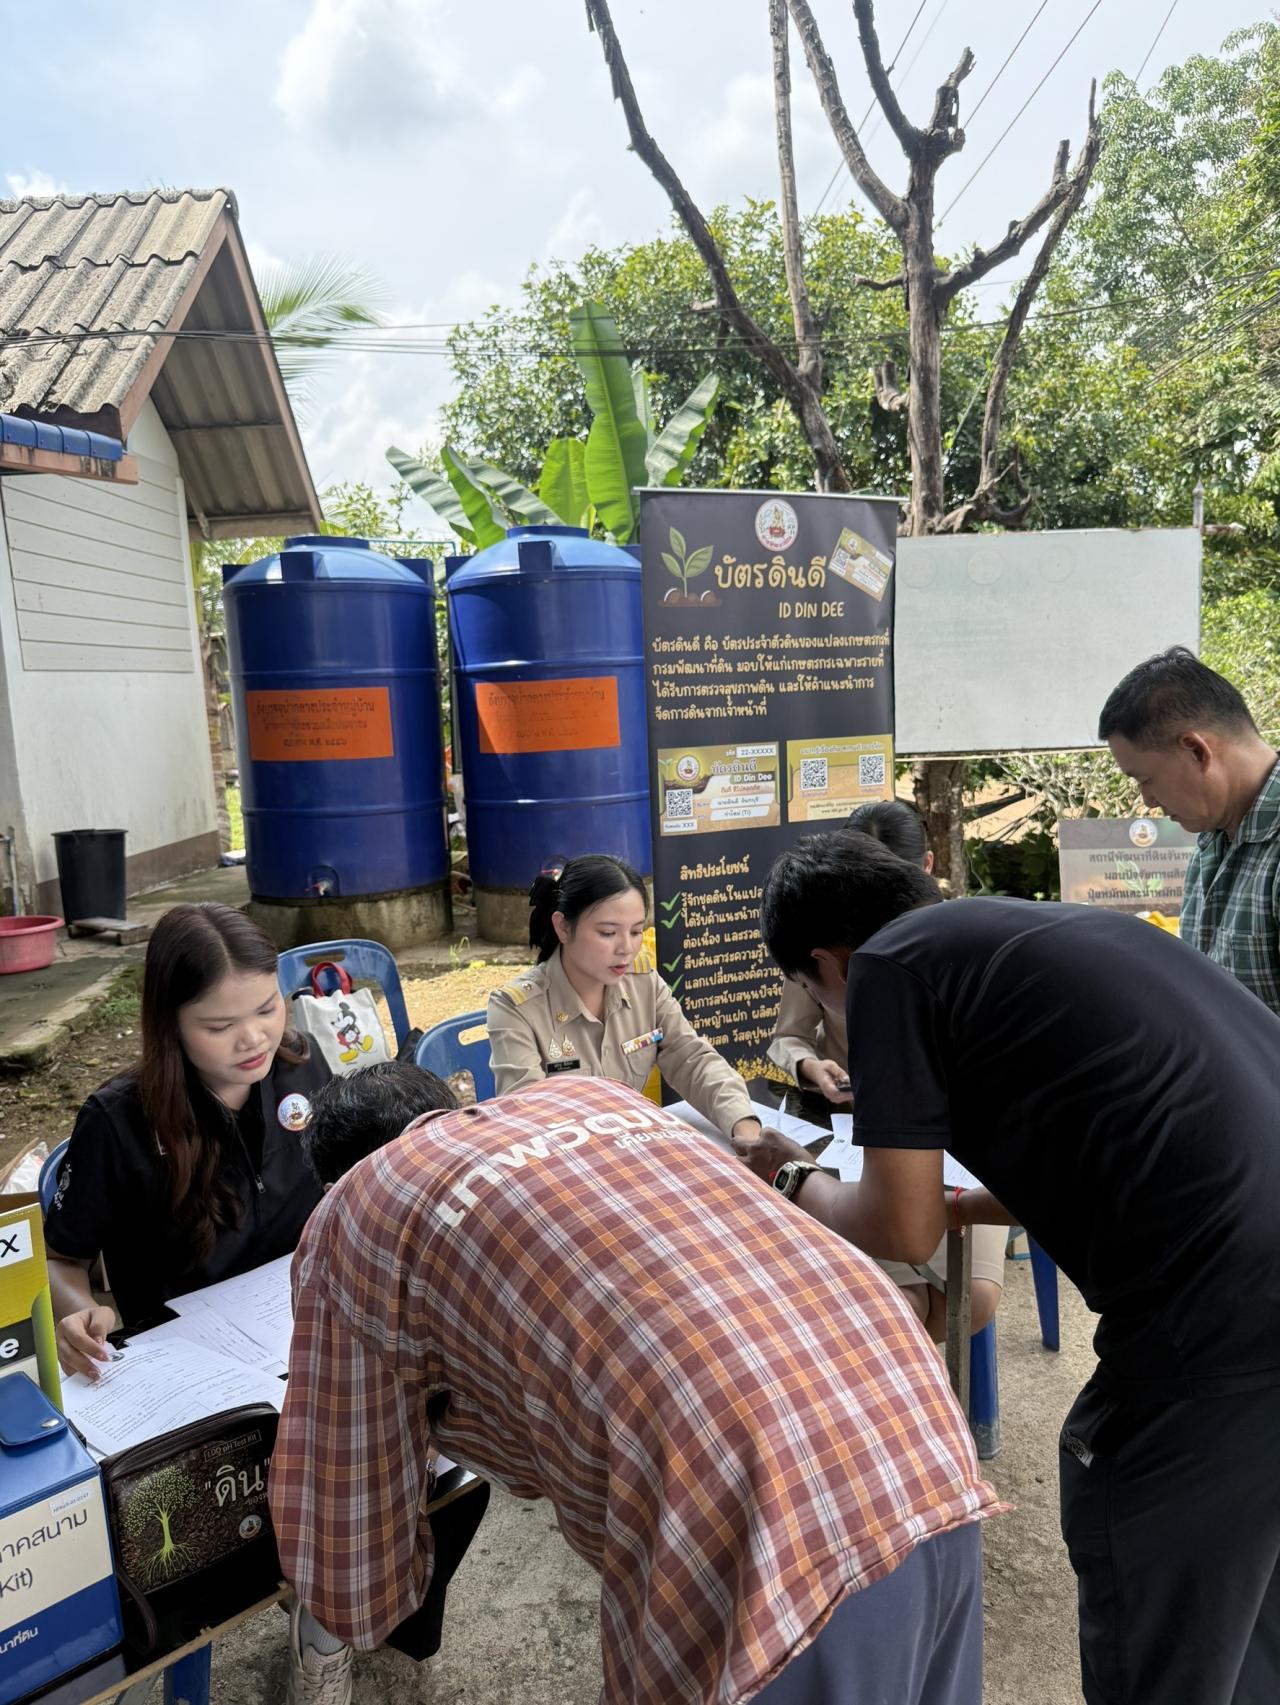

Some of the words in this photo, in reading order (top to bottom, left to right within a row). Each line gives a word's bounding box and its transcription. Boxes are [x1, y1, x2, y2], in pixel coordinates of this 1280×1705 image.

[714, 554, 828, 590] บัตรดินดี
[778, 602, 790, 618] ID
[795, 602, 817, 618] DIN
[822, 601, 844, 617] DEE
[652, 635, 700, 652] บัตรดินดี
[704, 635, 718, 651] คือ
[653, 653, 733, 675] กรมพัฒนาที่ดิน
[655, 697, 767, 721] จัดการดินจากเจ้าหน้าที่
[734, 774, 742, 782] ID
[744, 773, 756, 782] Din
[758, 773, 772, 781] Dee
[681, 854, 750, 880] สิทธิประโยชน์
[683, 928, 720, 949] ต่อเนื่อง
